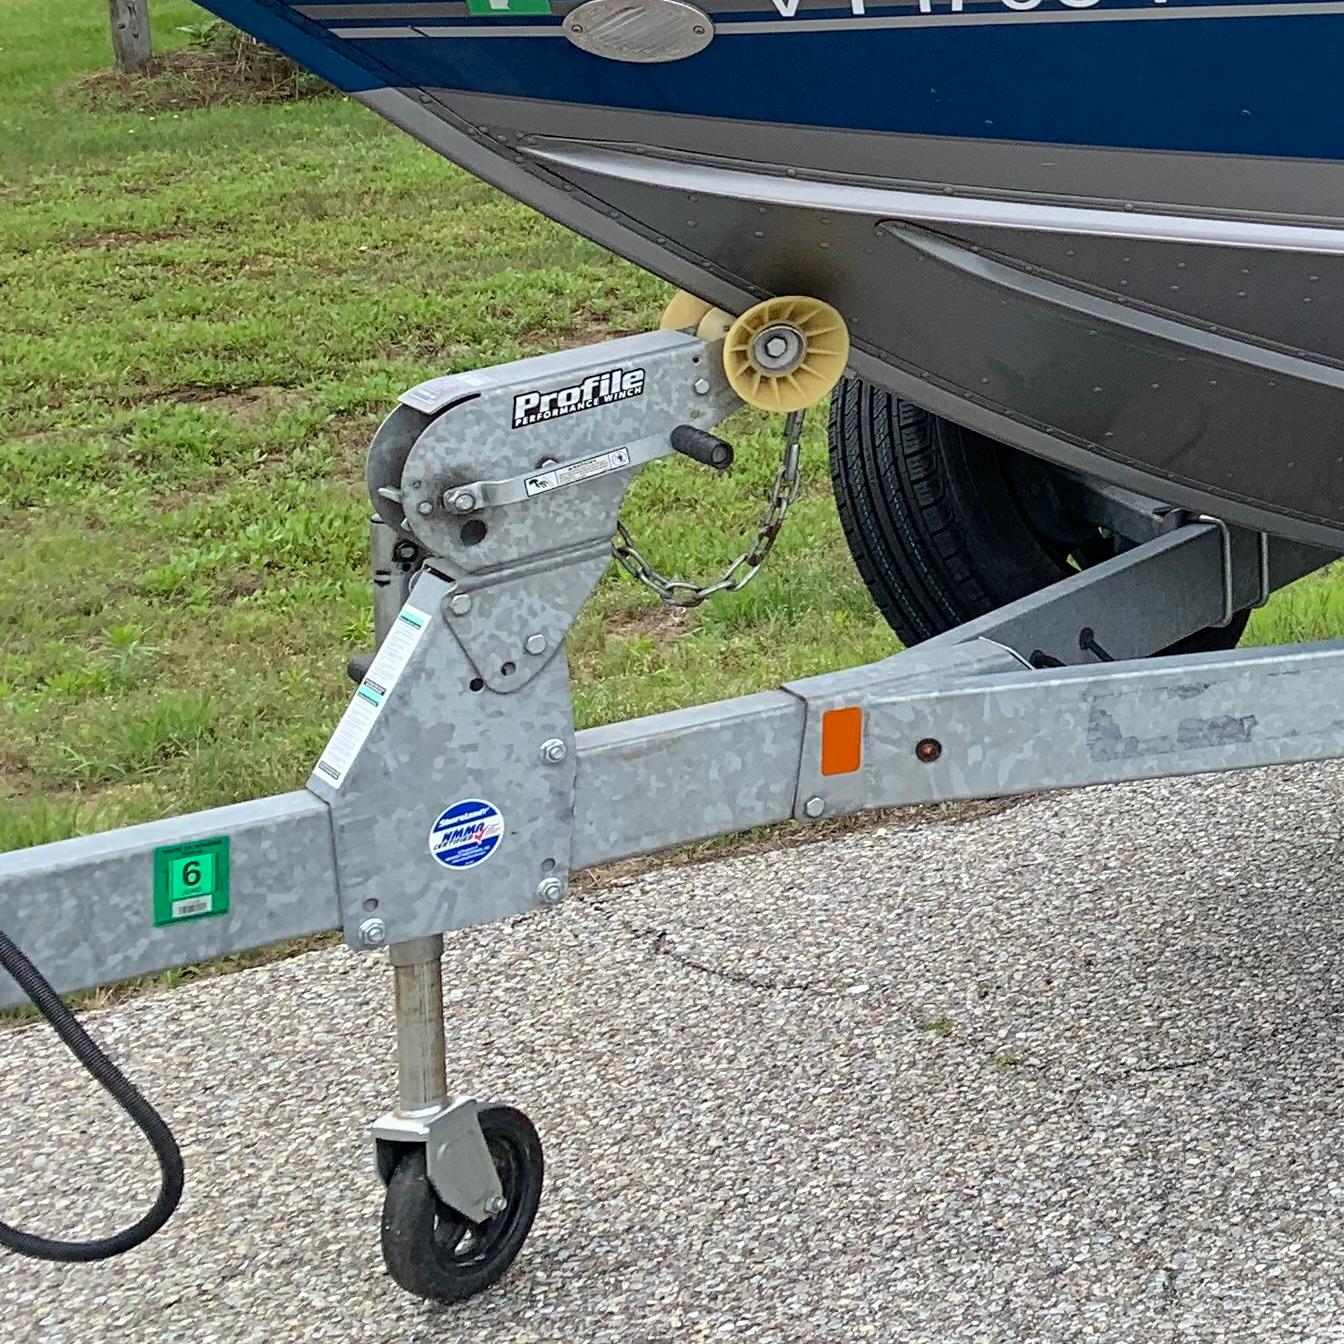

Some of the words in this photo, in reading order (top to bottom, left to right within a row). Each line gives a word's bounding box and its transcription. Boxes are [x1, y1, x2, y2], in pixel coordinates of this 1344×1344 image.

[514, 369, 644, 420] Profile
[515, 399, 599, 427] PERFORMANCE
[604, 387, 642, 403] WINCH
[182, 861, 202, 887] 6
